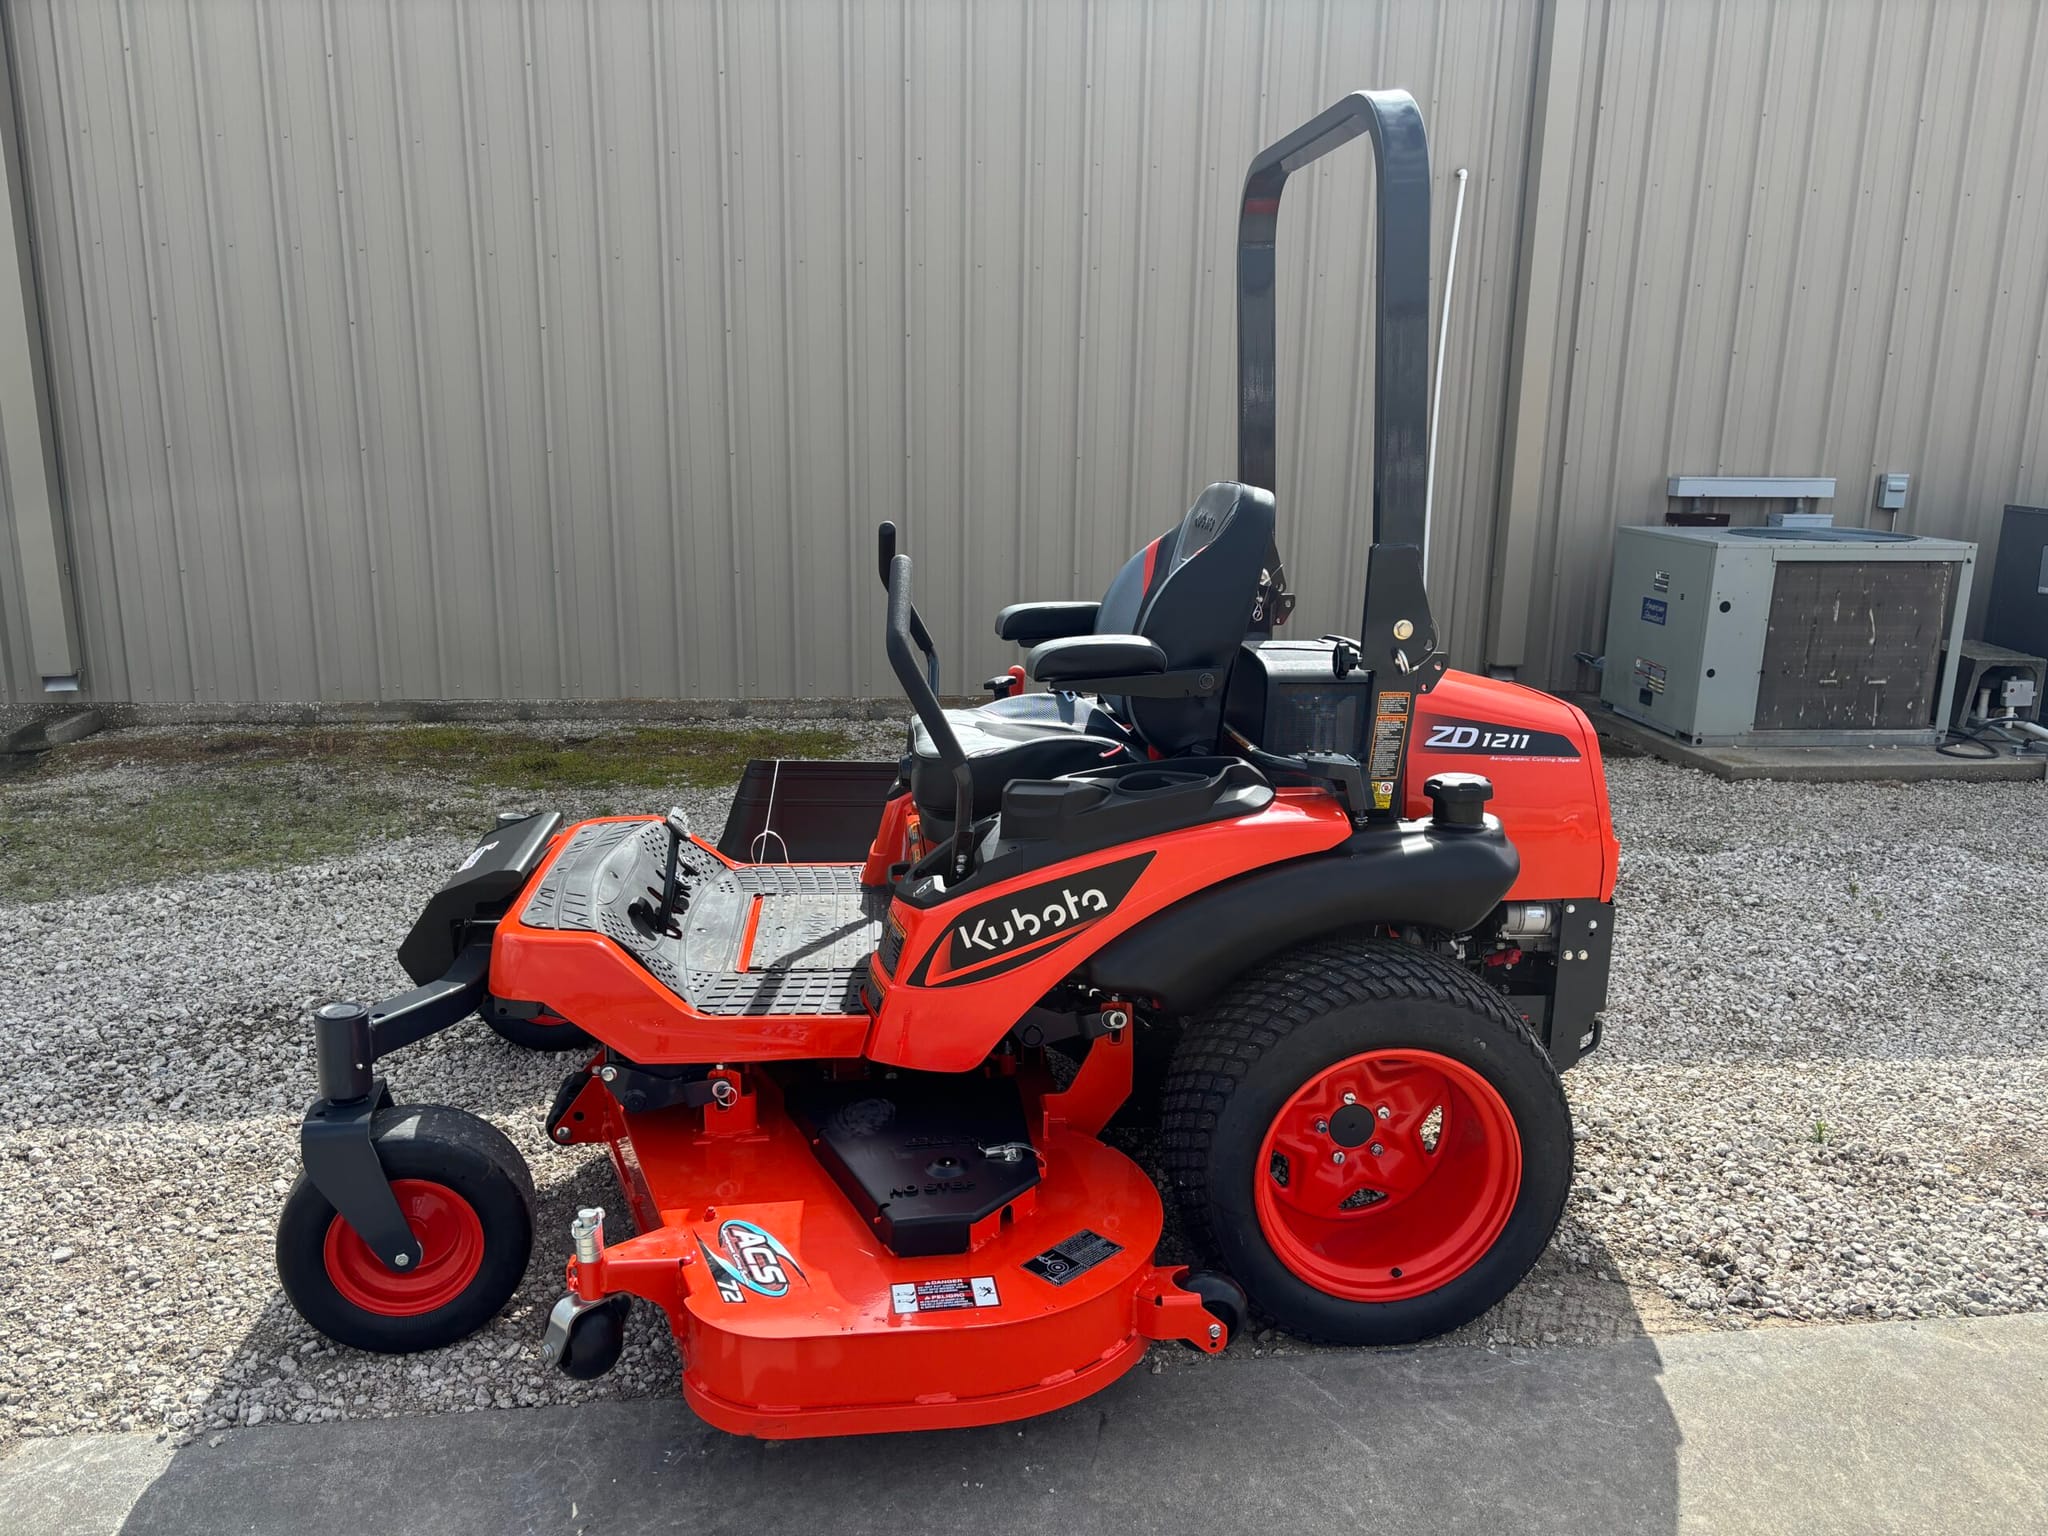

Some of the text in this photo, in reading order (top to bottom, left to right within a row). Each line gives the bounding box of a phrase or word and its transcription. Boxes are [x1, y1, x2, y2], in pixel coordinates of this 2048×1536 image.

[1424, 726, 1531, 749] ZD 1211
[959, 887, 1108, 951] Kubota
[889, 1184, 919, 1199] NO
[731, 1229, 788, 1284] ACS
[717, 1279, 745, 1302] 72
